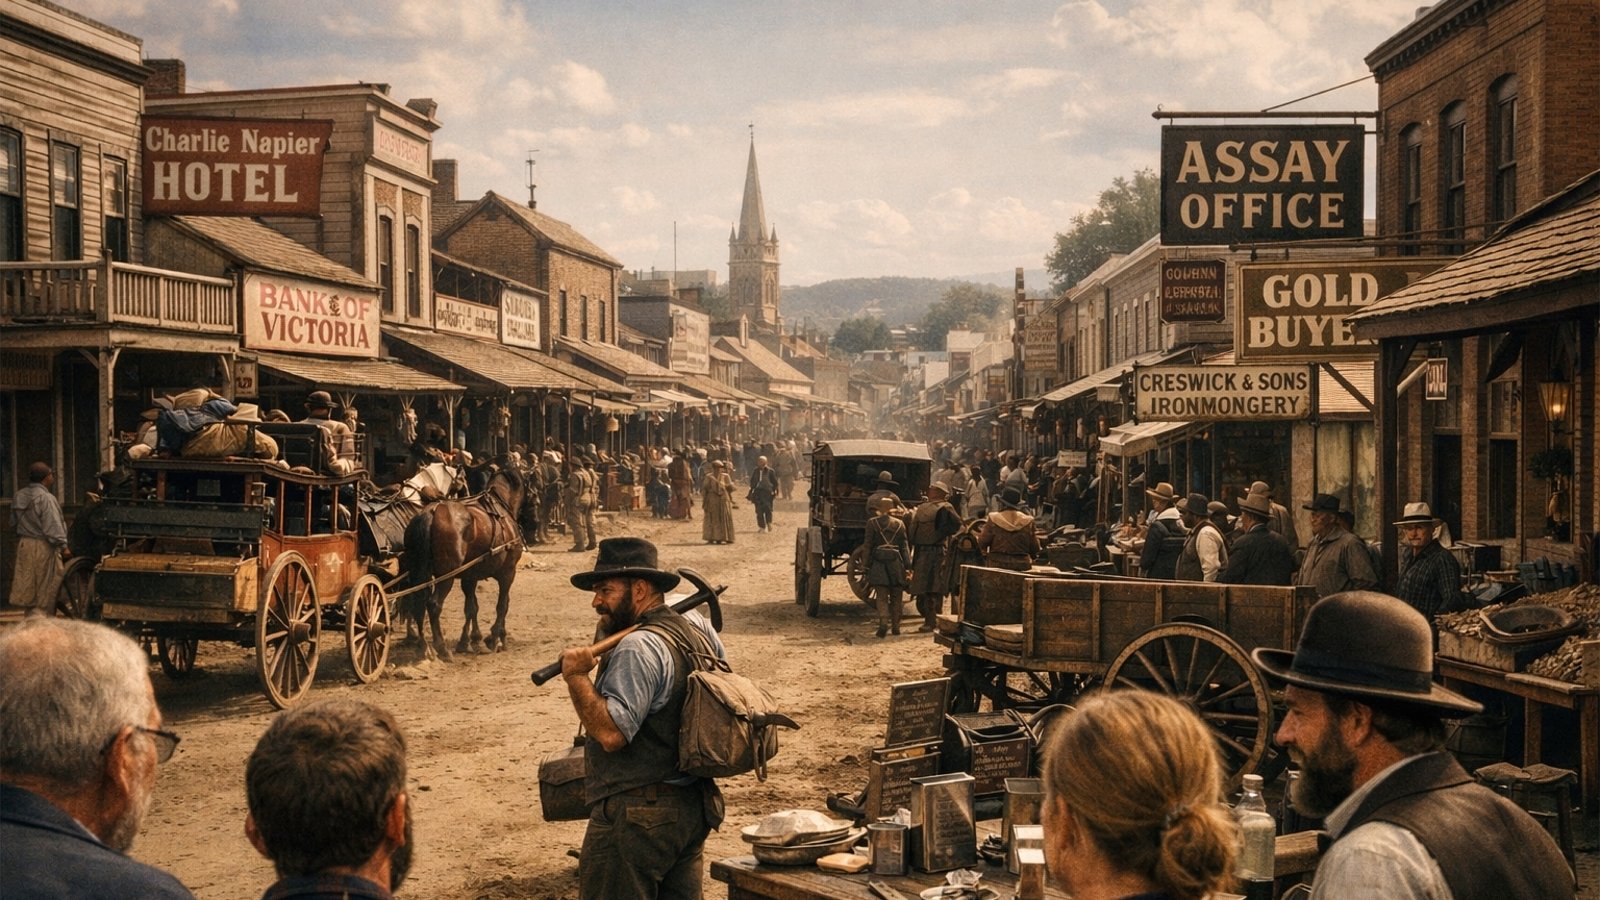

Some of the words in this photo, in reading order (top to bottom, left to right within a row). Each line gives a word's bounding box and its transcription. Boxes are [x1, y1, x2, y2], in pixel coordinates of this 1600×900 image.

[146, 126, 230, 152] Charlie
[241, 128, 320, 159] Napier
[1176, 140, 1350, 183] ASSAY
[152, 161, 299, 203] HOTEL
[1180, 193, 1345, 229] OFFICE
[259, 281, 328, 316] BANK
[343, 296, 372, 321] OF
[1263, 272, 1379, 309] GOLD
[261, 311, 370, 349] VICTORIA
[1248, 314, 1379, 348] BUYE
[1140, 373, 1237, 392] CRESWICK
[1242, 374, 1254, 391] &
[1258, 372, 1307, 390] SONS
[1151, 396, 1300, 415] IRONMONGERY
